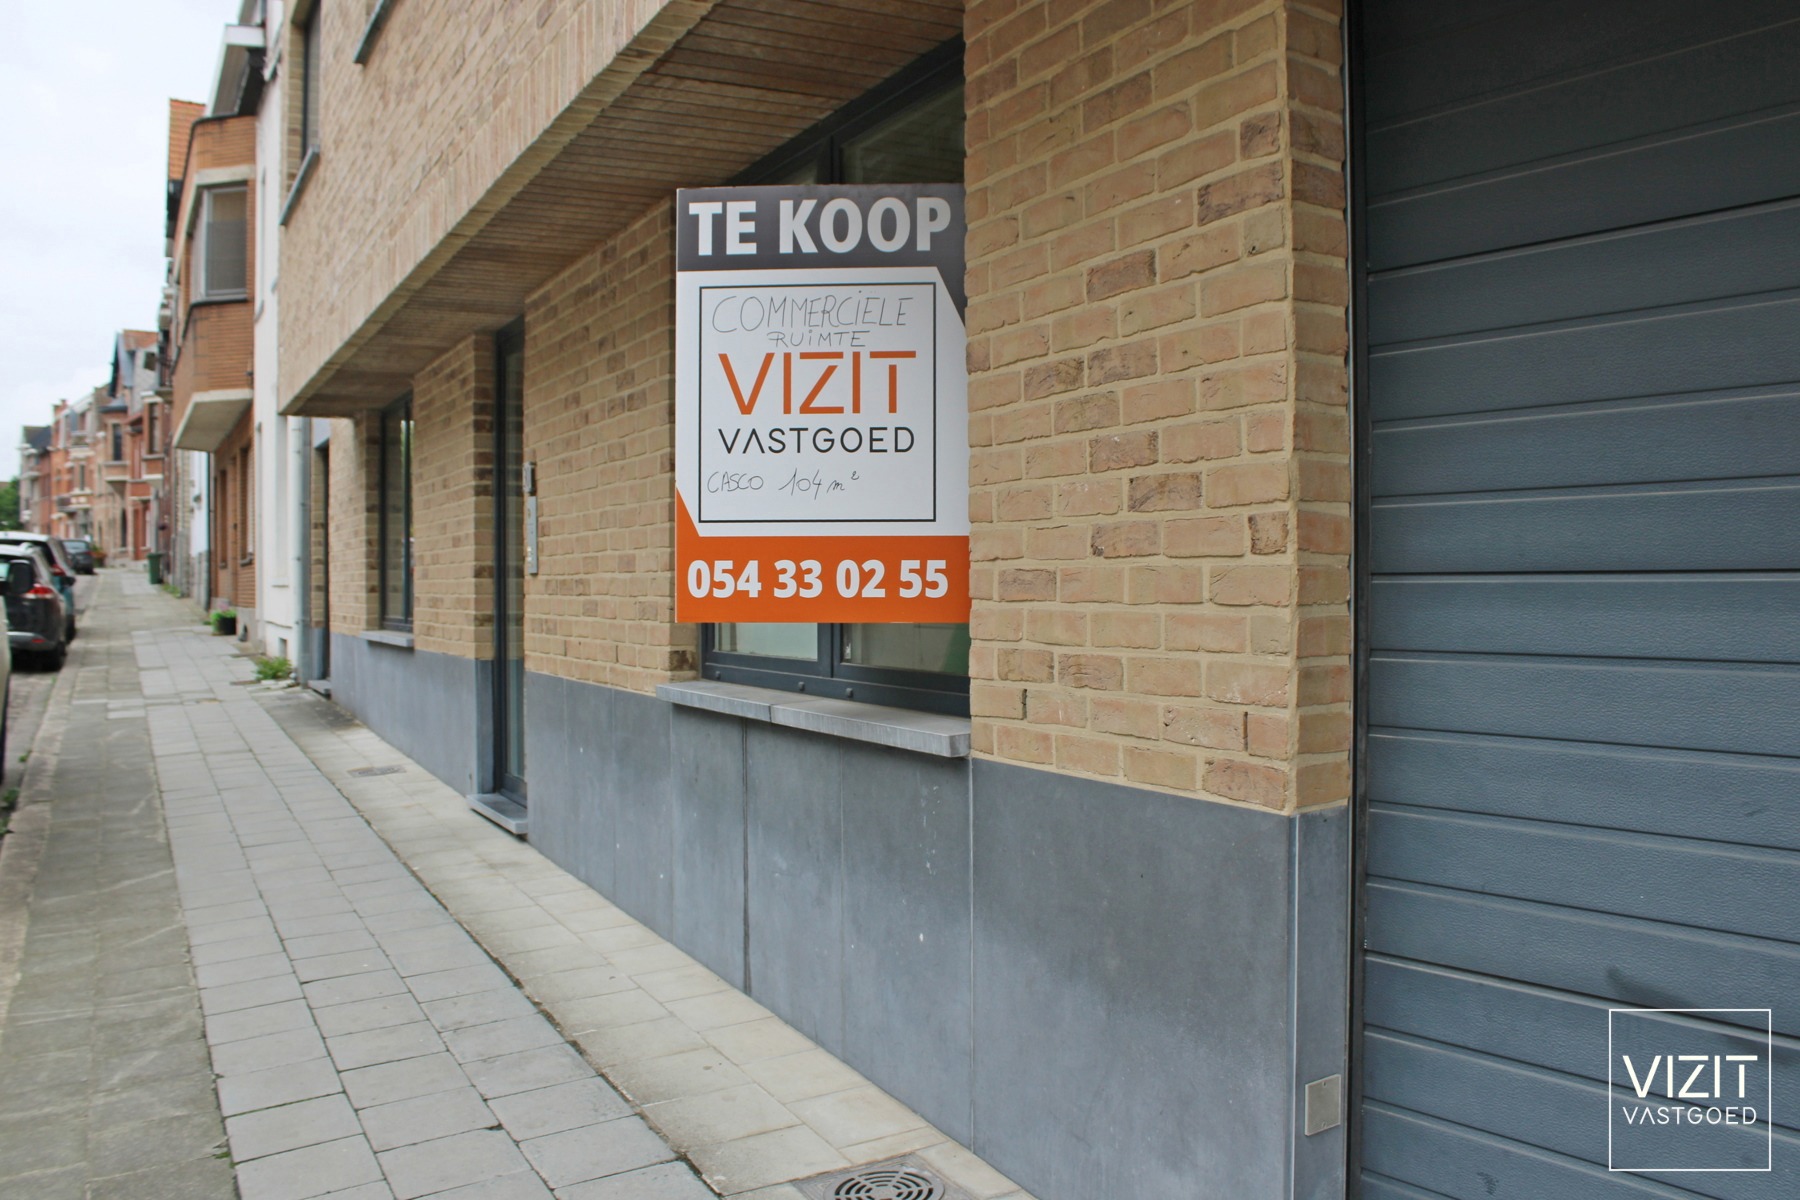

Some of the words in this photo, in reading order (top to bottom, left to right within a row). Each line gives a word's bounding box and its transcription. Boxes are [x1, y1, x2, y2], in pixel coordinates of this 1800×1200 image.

[688, 200, 757, 256] TE
[779, 197, 951, 253] KOOP
[718, 350, 917, 415] VIZIT
[717, 426, 915, 454] VASTGOED
[707, 471, 764, 494] CASCO
[778, 467, 823, 500] 104
[687, 559, 762, 598] 054
[773, 559, 823, 598] 33
[836, 559, 886, 598] 02
[899, 559, 949, 598] 55
